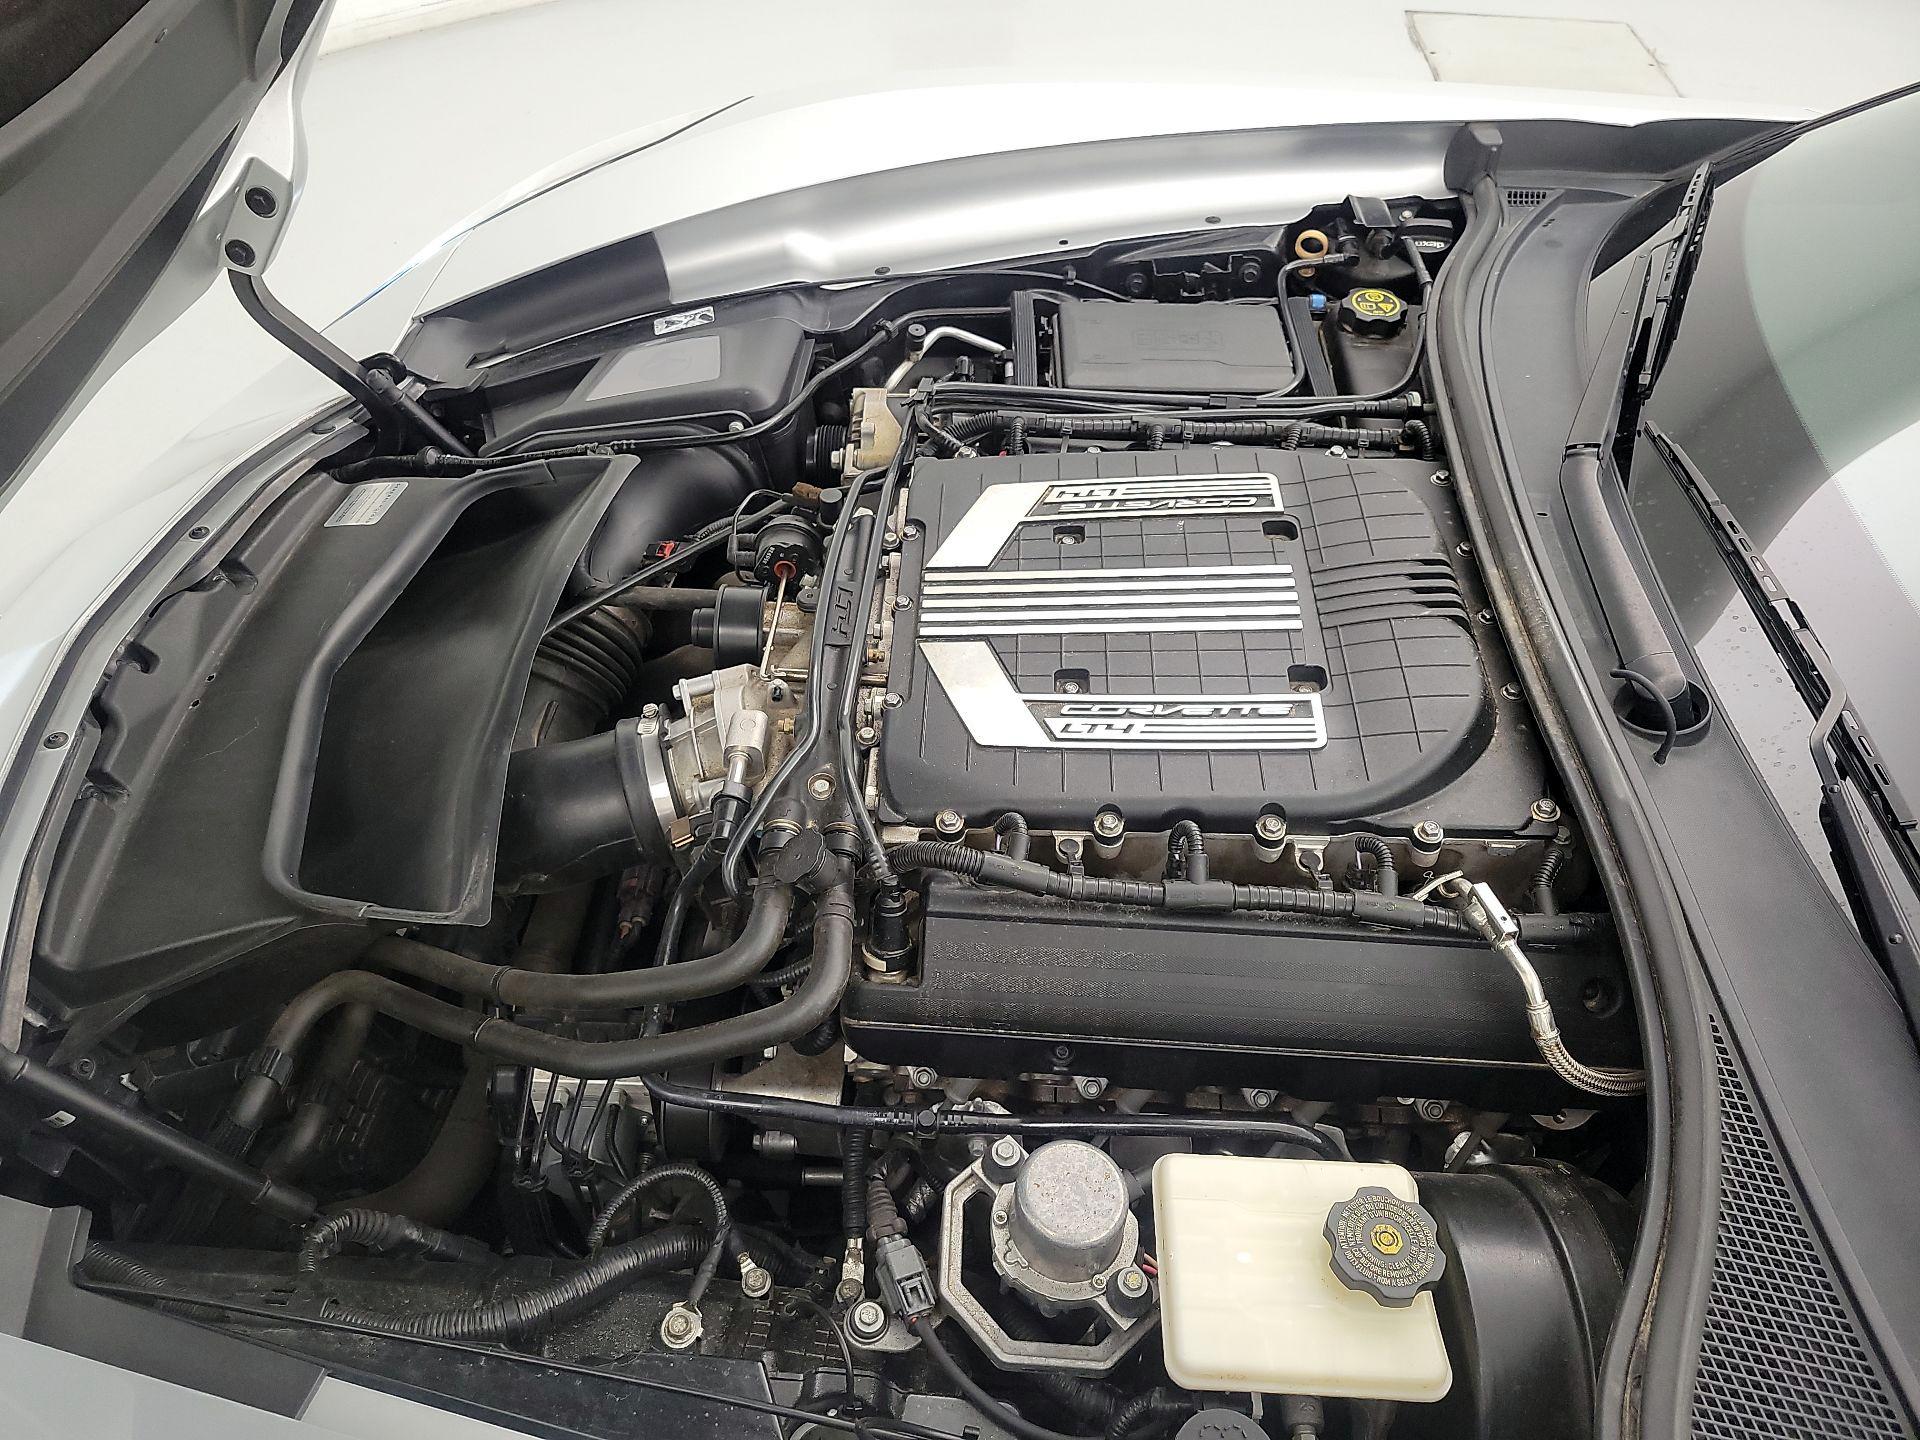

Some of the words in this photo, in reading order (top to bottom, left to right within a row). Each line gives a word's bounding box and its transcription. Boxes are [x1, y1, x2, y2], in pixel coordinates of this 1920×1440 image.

[1056, 488, 1118, 499] LT4
[1059, 496, 1258, 511] CORVETTE
[1059, 703, 1294, 717] CORVETTE
[1060, 723, 1135, 734] LT4
[1398, 1209, 1407, 1218] DE
[1400, 1202, 1420, 1219] AVANT
[1351, 1247, 1363, 1259] CAP
[1358, 1257, 1382, 1275] BEFORE
